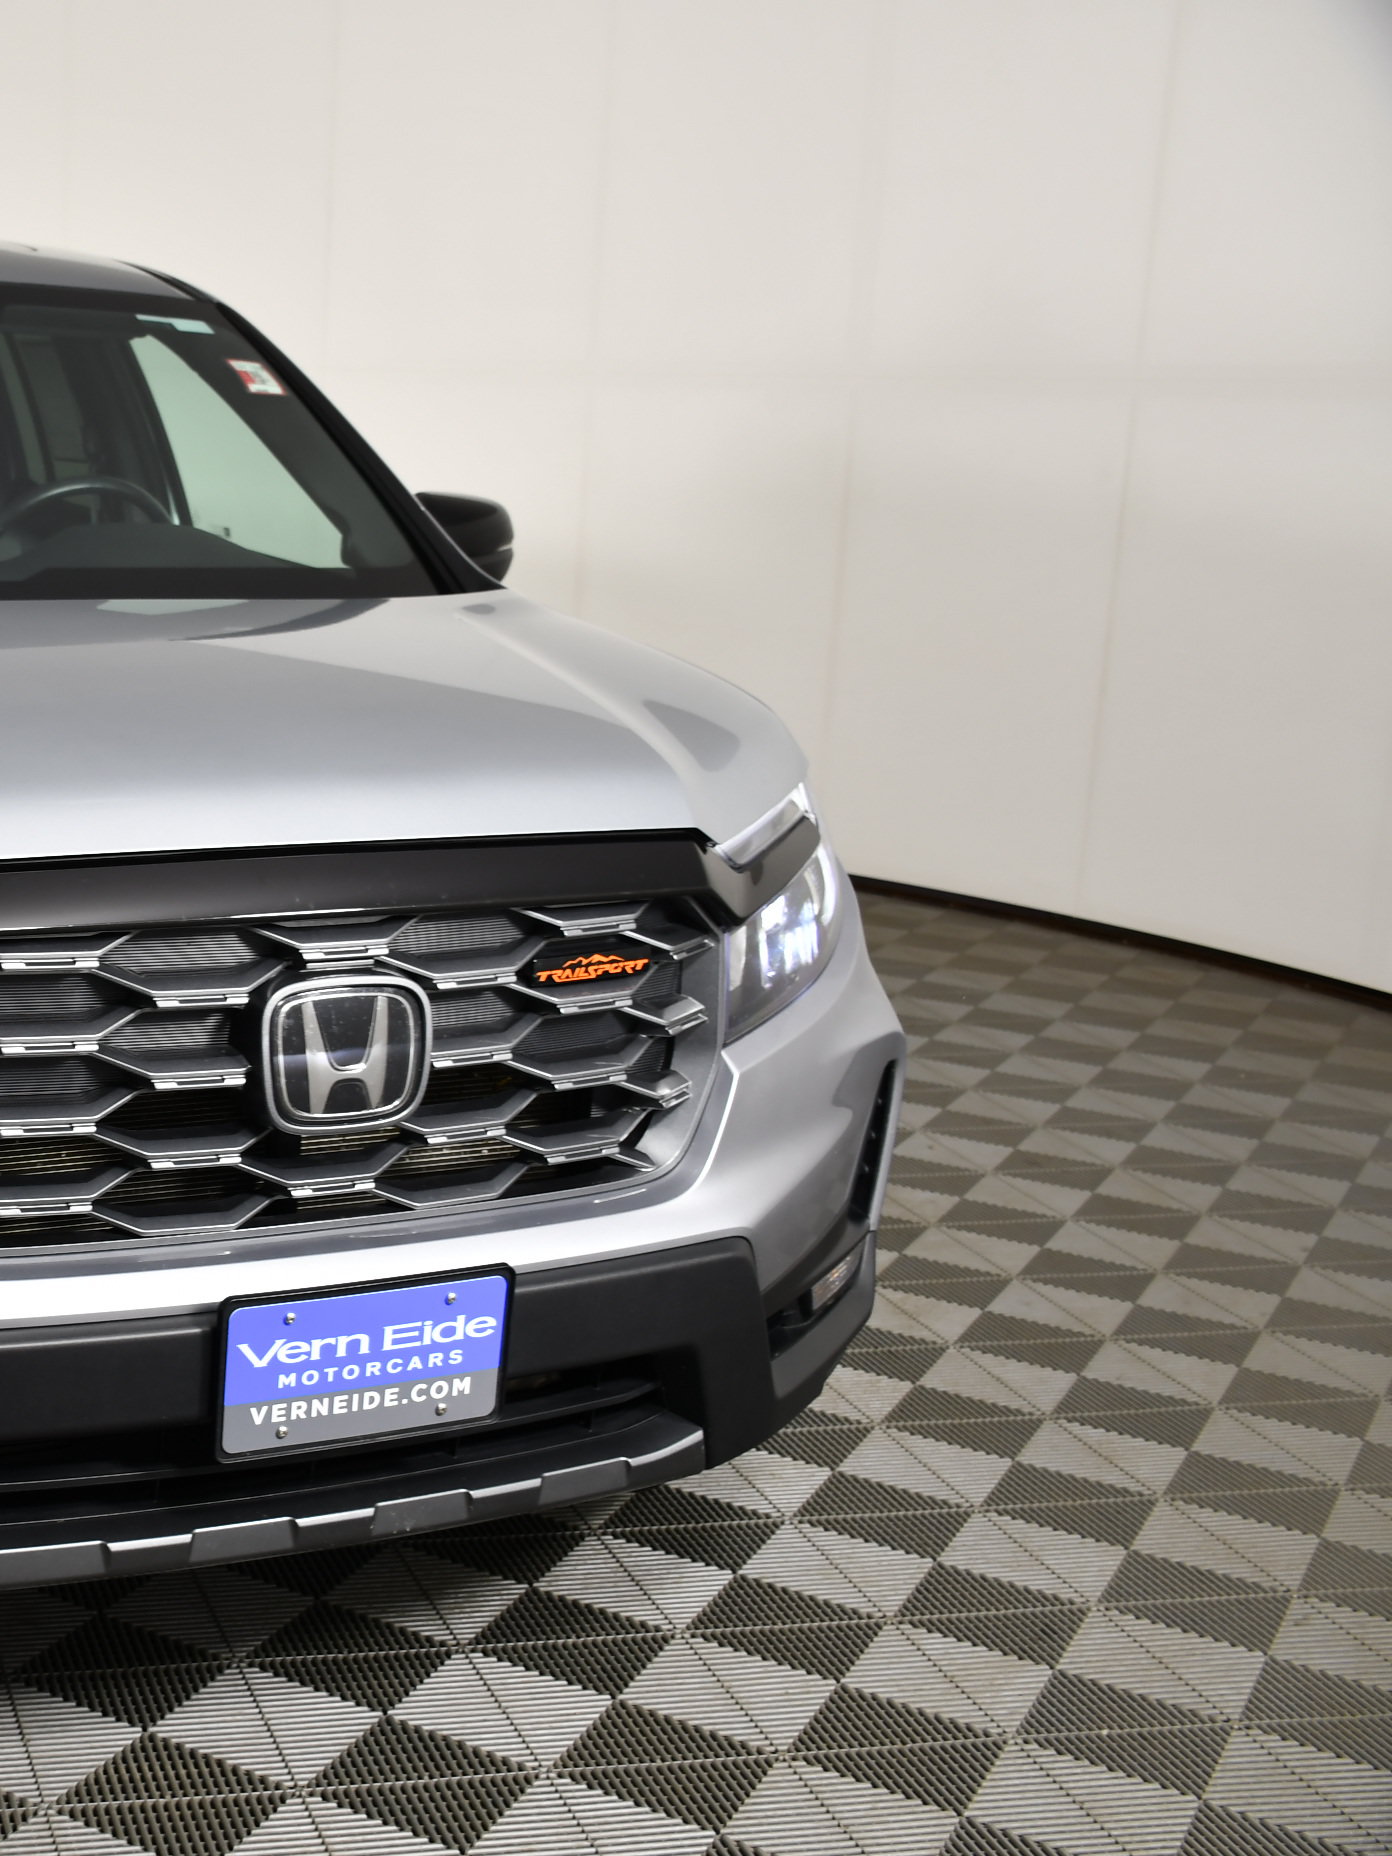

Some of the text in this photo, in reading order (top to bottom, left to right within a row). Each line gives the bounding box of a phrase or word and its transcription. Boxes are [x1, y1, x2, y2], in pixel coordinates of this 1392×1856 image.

[536, 958, 649, 983] TRAILSPORT
[236, 1314, 497, 1368] Vern Eide
[277, 1350, 464, 1388] MOTORCARS
[249, 1376, 472, 1426] VERNEIDE.COM
